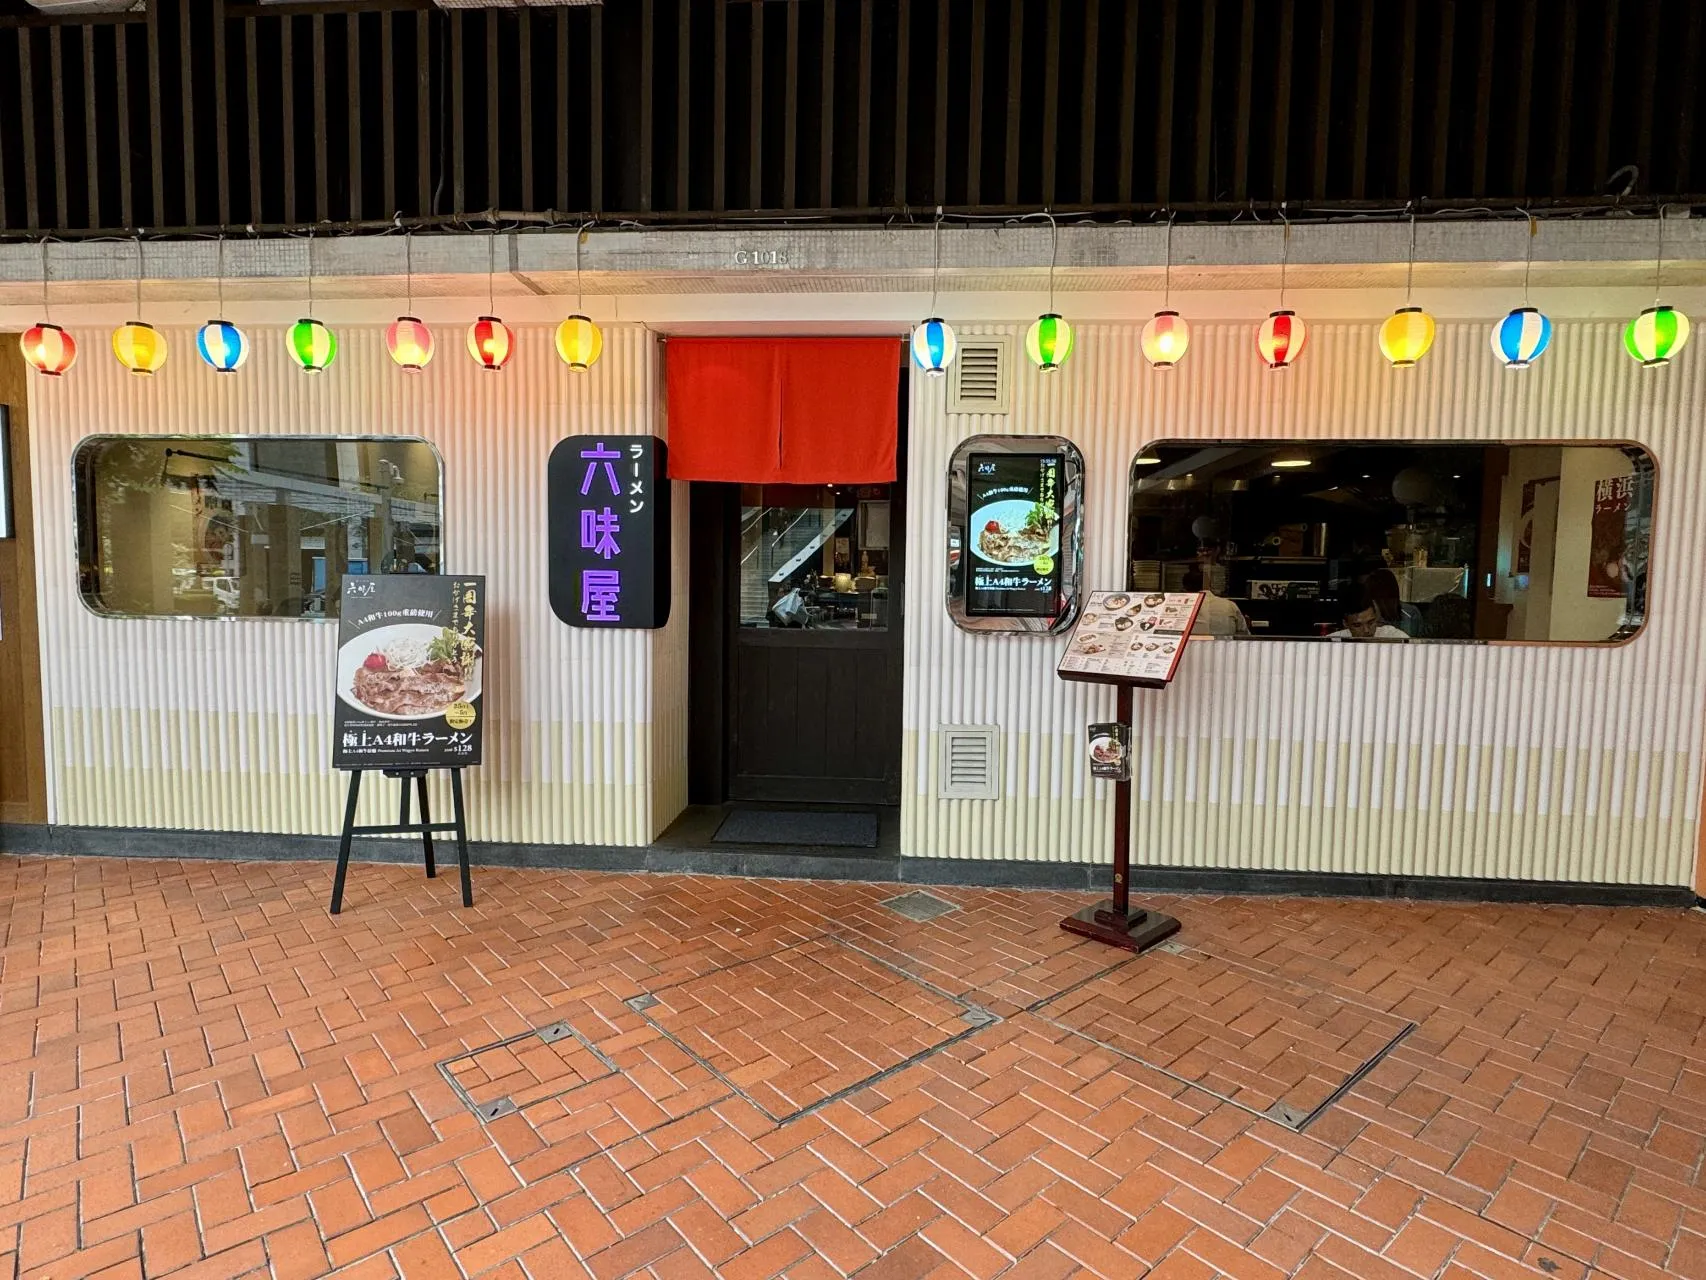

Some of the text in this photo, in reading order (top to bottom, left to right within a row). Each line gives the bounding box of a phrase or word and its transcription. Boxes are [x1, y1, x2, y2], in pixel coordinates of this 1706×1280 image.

[629, 443, 645, 513] ラーメン
[1597, 476, 1634, 502] 横浜
[1595, 503, 1632, 514] ラーメン
[580, 442, 621, 621] 六味屋
[342, 730, 473, 747] 極上A4和牛ラーメン
